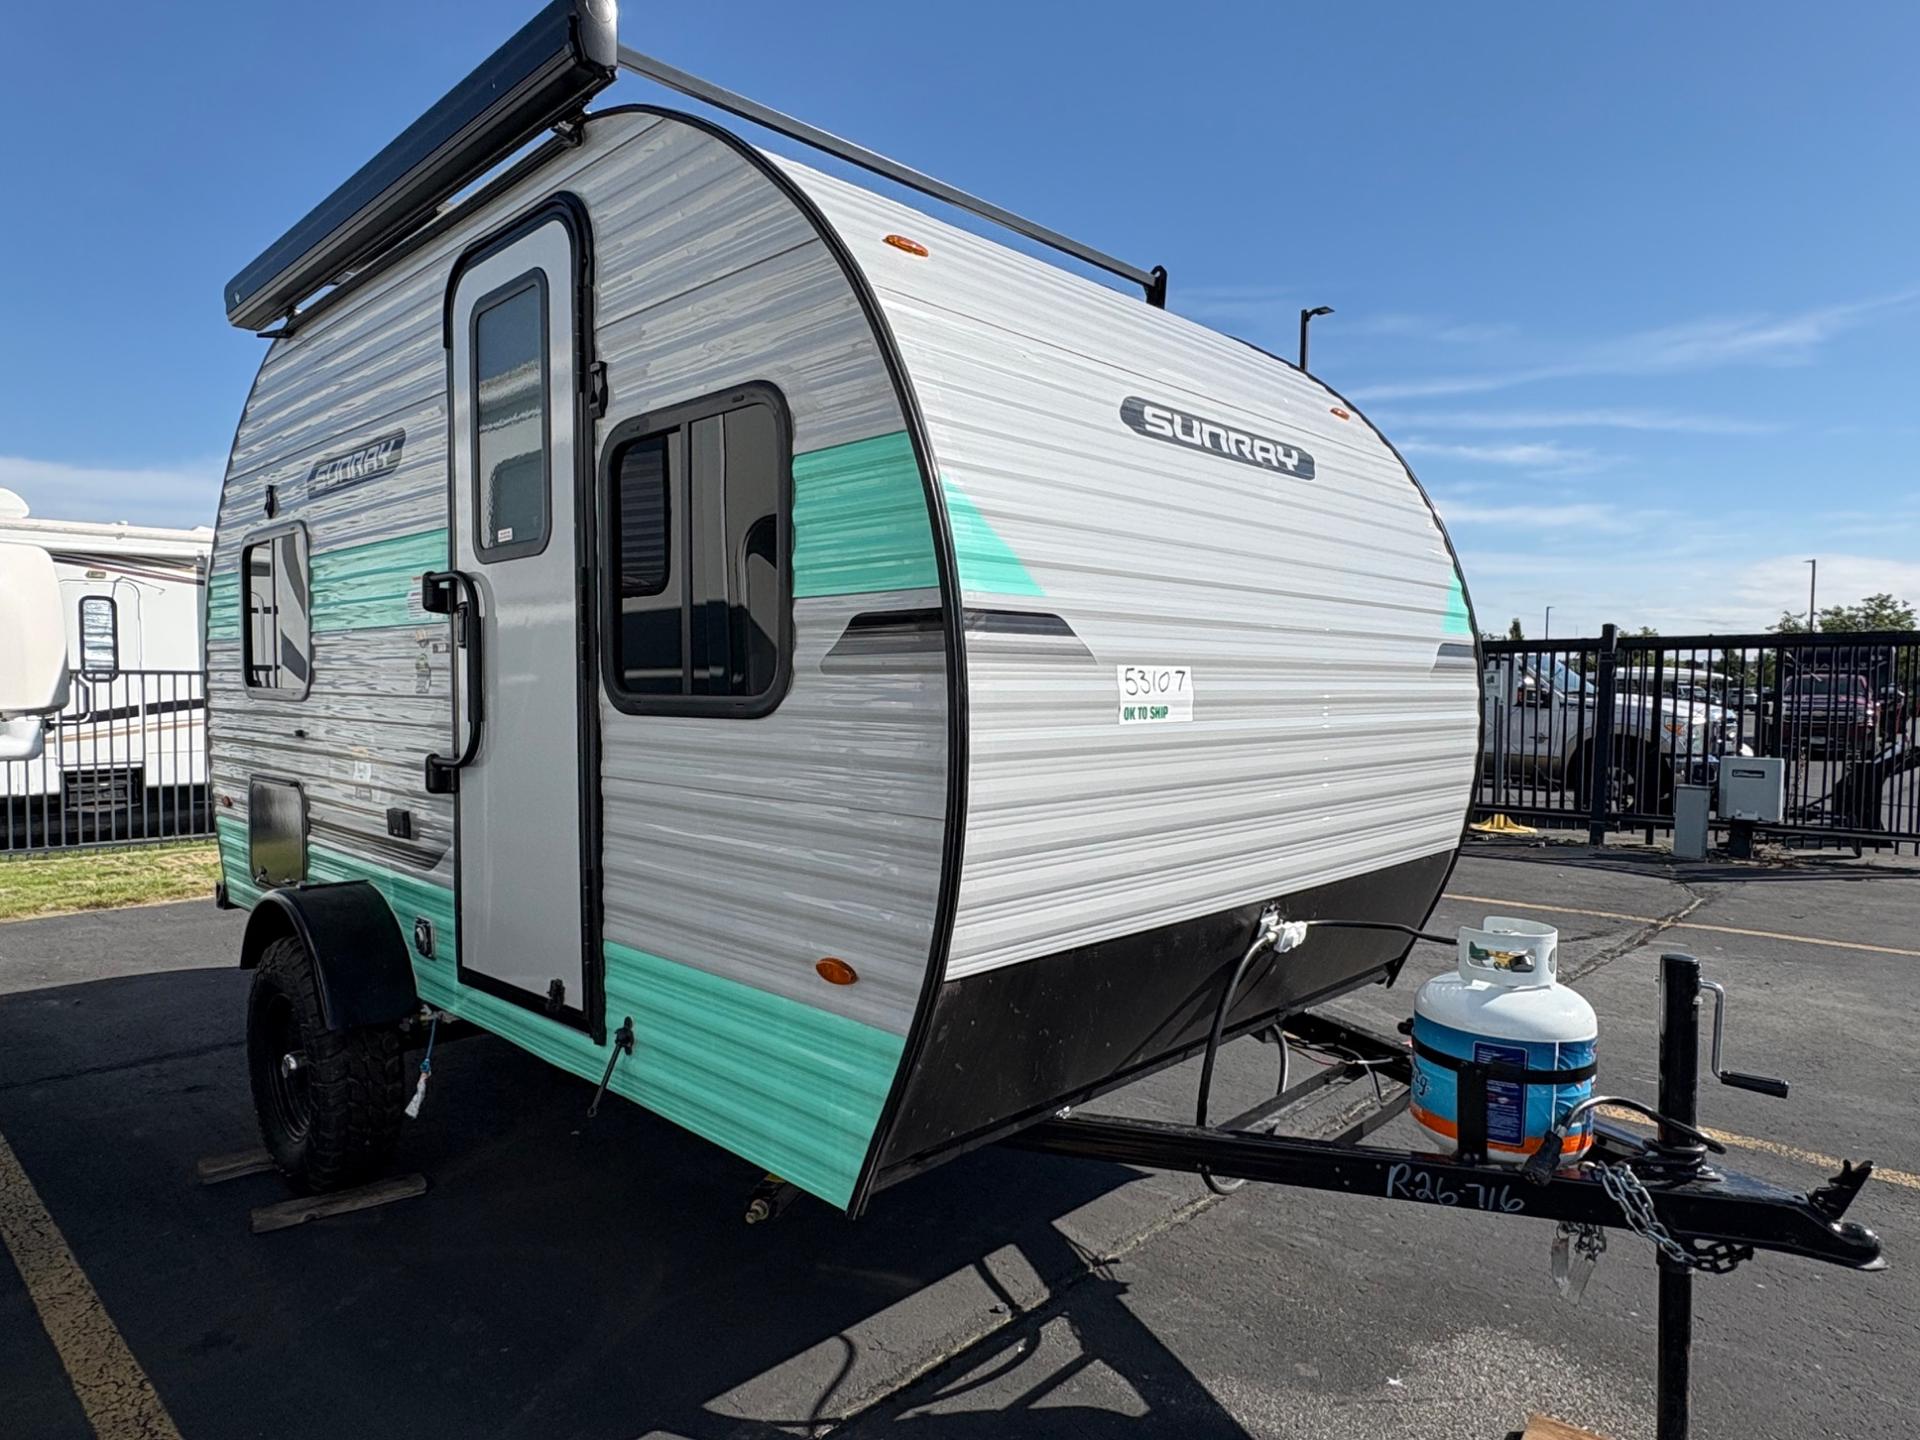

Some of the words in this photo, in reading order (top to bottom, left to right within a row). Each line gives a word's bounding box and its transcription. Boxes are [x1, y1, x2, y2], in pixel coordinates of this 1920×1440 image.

[1143, 405, 1299, 472] SUNRAY
[314, 440, 396, 489] SUNRAY
[1125, 667, 1186, 696] 53107
[1123, 706, 1136, 721] OK
[1137, 706, 1148, 720] TO
[1149, 705, 1169, 720] SHIP
